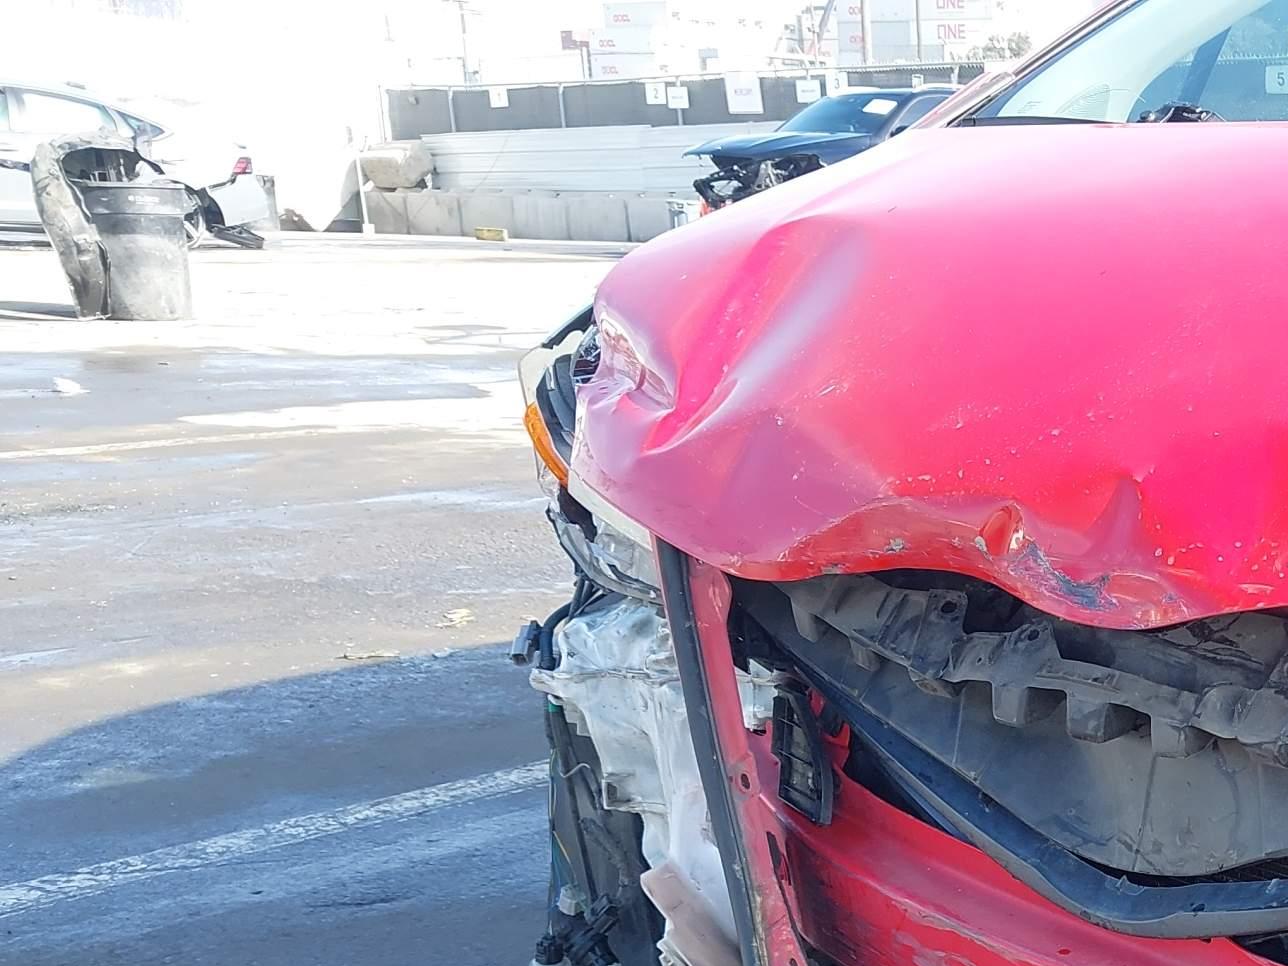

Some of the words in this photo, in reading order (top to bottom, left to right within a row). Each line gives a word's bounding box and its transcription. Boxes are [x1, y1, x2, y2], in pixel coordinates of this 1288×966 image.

[937, 23, 966, 40] ONE
[834, 78, 840, 89] 3
[1277, 72, 1285, 87] 5
[653, 87, 660, 99] 2
